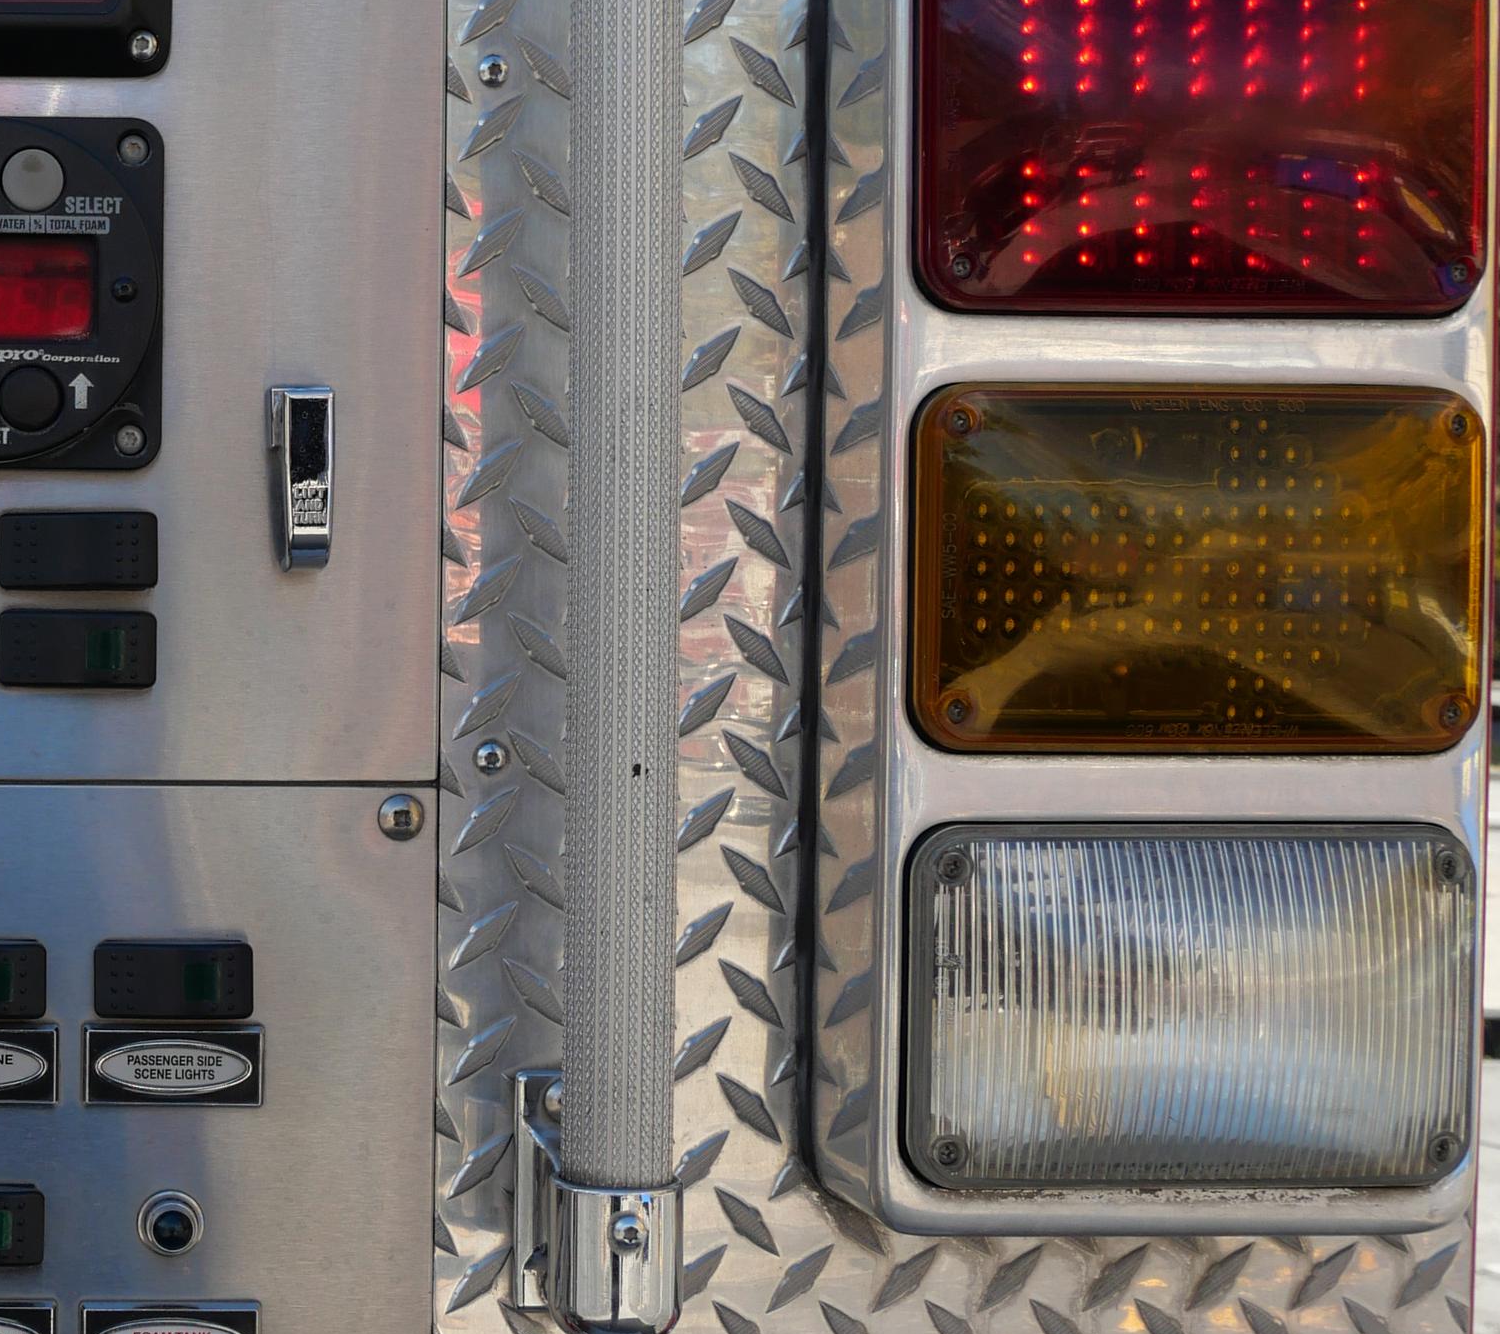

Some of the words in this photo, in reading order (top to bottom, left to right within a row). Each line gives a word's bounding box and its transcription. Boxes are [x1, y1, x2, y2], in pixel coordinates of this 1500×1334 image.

[65, 196, 123, 215] SELECT
[49, 219, 77, 231] TOTAL
[79, 219, 106, 231] FOAM
[127, 1055, 194, 1067] PASSENGER
[197, 1055, 222, 1067] SIDE
[134, 1069, 172, 1080] SCENE
[175, 1069, 215, 1081] LIGHTS
